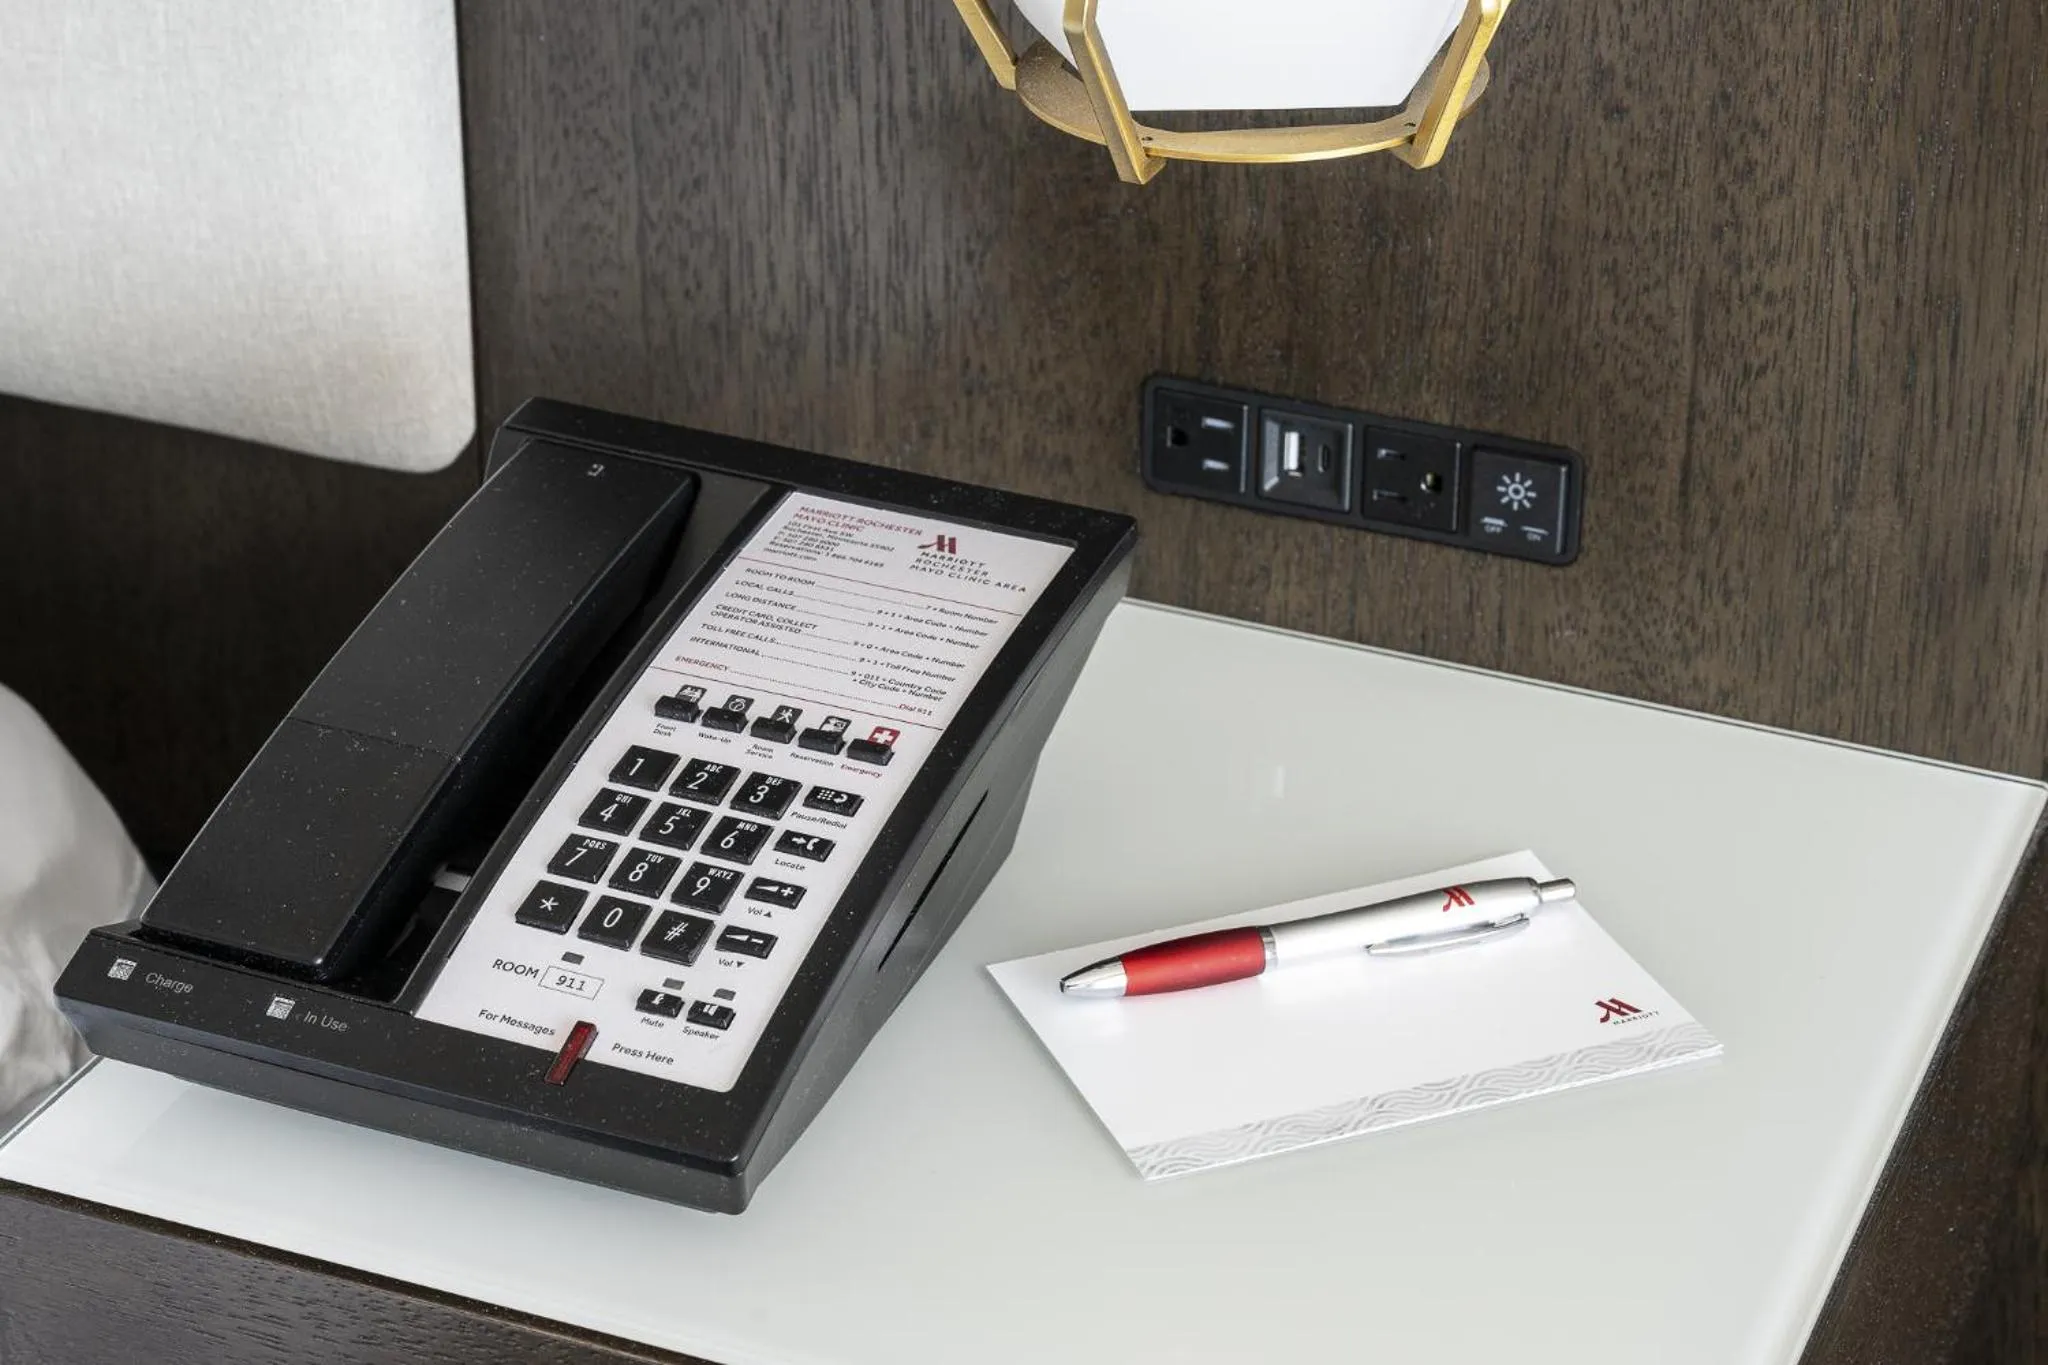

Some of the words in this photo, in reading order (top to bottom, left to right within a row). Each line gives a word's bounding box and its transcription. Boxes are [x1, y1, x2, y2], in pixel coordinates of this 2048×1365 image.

[793, 513, 826, 523] MAYO
[827, 519, 865, 532] CLINIC
[800, 506, 856, 520] MARRIOTT
[857, 517, 923, 536] ROCHESTER
[1483, 524, 1503, 534] OFF
[915, 558, 989, 577] ROCHESTER
[921, 551, 987, 567] MARRIOTT
[909, 564, 944, 576] MAYO
[948, 572, 991, 585] CLINIC
[995, 581, 1026, 593] AREA
[745, 567, 773, 578] ROOM
[774, 572, 787, 580] TO
[787, 575, 816, 586] ROOM
[938, 608, 963, 617] Room
[964, 613, 999, 625] Number
[716, 603, 748, 615] CREDIT
[776, 617, 818, 630] COLLECT
[735, 579, 764, 590] LOCAL
[766, 585, 795, 596] CALLS
[904, 614, 923, 623] Area
[925, 618, 947, 628] Code
[955, 625, 988, 636] Number
[725, 591, 751, 601] LONG
[752, 597, 797, 611] DISTANCE
[894, 627, 914, 636] Area
[915, 631, 937, 641] Code
[945, 638, 980, 650] Number
[710, 610, 758, 624] OPERATOR
[757, 620, 801, 634] ASSISTED
[879, 646, 900, 655] Area
[901, 650, 923, 660] Code
[931, 657, 966, 669] Number
[701, 623, 722, 633] TOLL
[724, 628, 746, 639] FREE
[747, 633, 776, 644] CALLS
[885, 662, 901, 671] Toll
[901, 666, 921, 675] Free
[922, 670, 956, 682] Number
[689, 636, 760, 656] INTERNATIONAL
[888, 678, 922, 691] Country
[924, 686, 947, 695] Code
[674, 655, 730, 672] EMERGENCY
[899, 703, 916, 712] Dial
[858, 679, 876, 689] City
[877, 683, 900, 693] Code
[908, 689, 943, 702] Number
[653, 728, 672, 737] Desk
[699, 732, 731, 743] Wake-Up
[745, 748, 773, 759] Service
[752, 744, 773, 753] Room
[629, 757, 645, 776] 1
[704, 763, 724, 773] ABC
[790, 751, 834, 767] Reservation
[840, 763, 883, 778] Emergency
[686, 771, 709, 790] 2
[765, 776, 782, 786] DEF
[615, 793, 633, 804] GHI
[749, 785, 770, 803] 3
[600, 803, 619, 822] 4
[676, 807, 692, 817] JKL
[790, 811, 847, 830] Pause/Redial
[659, 815, 680, 835] 5
[735, 821, 758, 832] MNO
[582, 838, 608, 850] PQRS
[720, 830, 740, 849] 6
[565, 847, 588, 866] 7
[645, 853, 665, 864] TUV
[774, 857, 806, 871] Locate
[628, 862, 649, 882] 8
[708, 868, 735, 880] WXYZ
[692, 877, 711, 897] 9
[603, 907, 623, 929] 0
[748, 906, 762, 916] Vol
[718, 957, 734, 967] Vol
[145, 971, 194, 995] Charge
[491, 958, 540, 979] ROOM
[555, 975, 587, 992] 911
[303, 1009, 318, 1024] In
[321, 1015, 349, 1032] Use
[478, 1009, 499, 1021] For
[499, 1013, 556, 1037] Messages
[640, 1016, 665, 1029] Mute
[1613, 1010, 1659, 1025] MARRIOTT
[682, 1025, 720, 1042] Speaker
[611, 1043, 644, 1059] Press
[646, 1052, 675, 1066] Here
